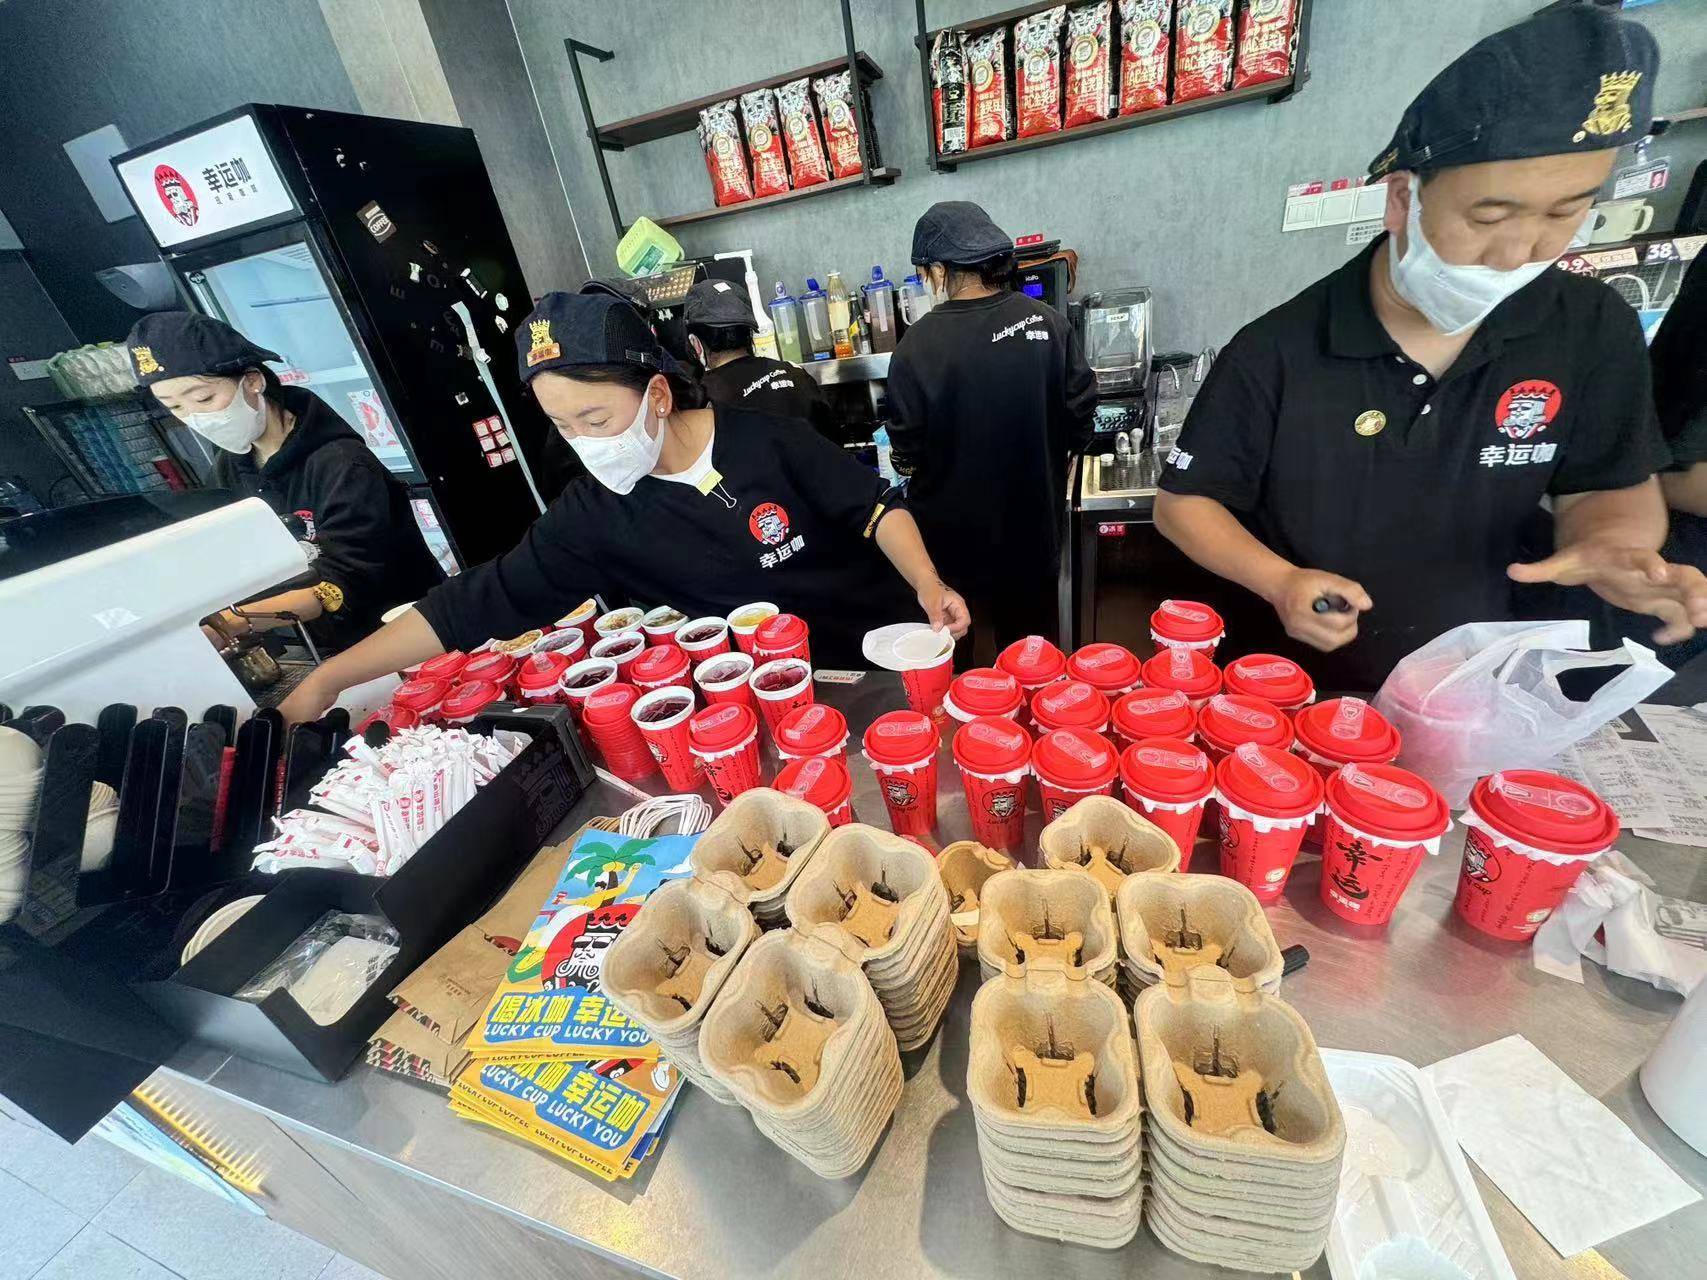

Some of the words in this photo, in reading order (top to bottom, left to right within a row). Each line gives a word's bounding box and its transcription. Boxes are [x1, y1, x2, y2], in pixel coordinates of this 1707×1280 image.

[202, 157, 252, 194] 幸运咖
[1648, 243, 1673, 260] 38
[992, 320, 1026, 343] Luckycup
[1479, 442, 1558, 468] 幸运咖
[759, 534, 806, 569] 幸运咖
[490, 994, 574, 1024] 喝冰咖
[573, 995, 640, 1029] 幸运
[485, 1023, 528, 1037] LUCKY
[533, 1024, 561, 1038] CUP
[564, 1026, 616, 1042] LUCKY
[620, 1030, 650, 1044] YOU
[481, 1064, 523, 1092] LUCKY
[521, 1085, 549, 1106] CUP
[547, 1100, 594, 1132] LUCKY
[592, 1123, 623, 1148] YOU
[562, 1070, 647, 1132] 幸运咖
